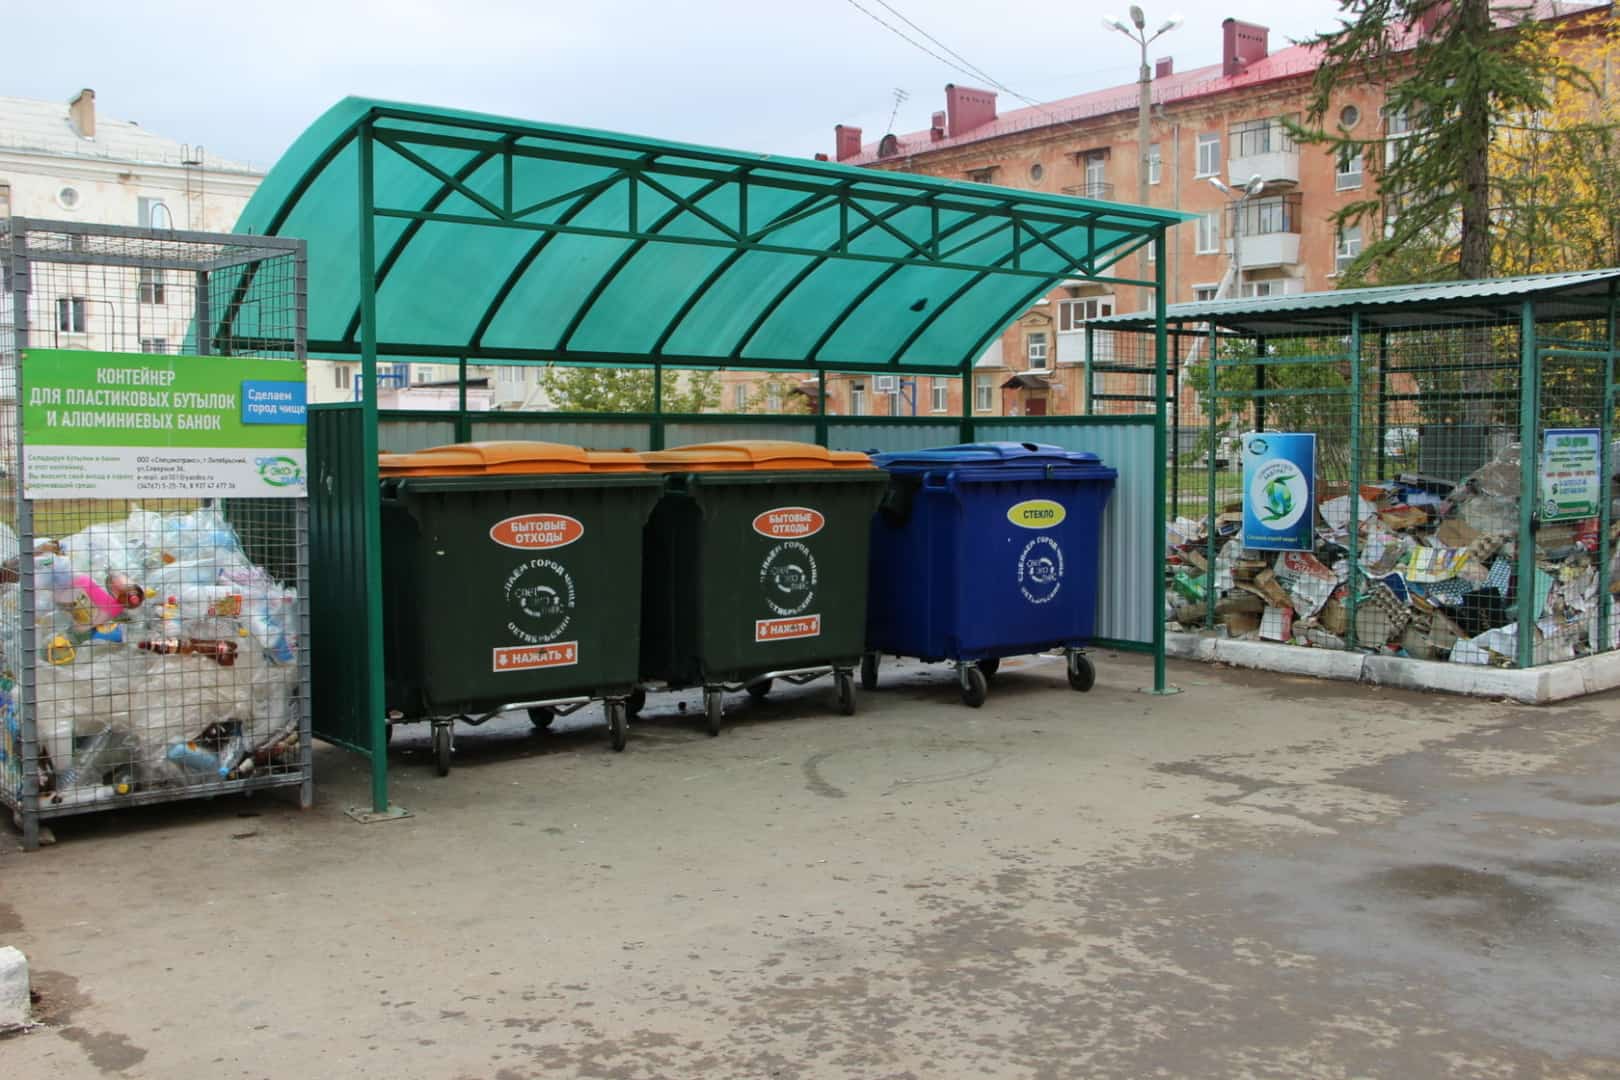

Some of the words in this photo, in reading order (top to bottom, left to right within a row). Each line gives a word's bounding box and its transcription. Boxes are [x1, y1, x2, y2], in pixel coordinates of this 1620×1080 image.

[96, 367, 176, 386] КОНТЕЙНЕР
[30, 387, 61, 406] ДЛЯ
[66, 388, 170, 408] ПЛАСТИКОВЫХ
[173, 392, 236, 409] БУТЫЛОК
[248, 389, 292, 403] Сделаем
[248, 403, 277, 415] город
[279, 404, 305, 416] чище
[47, 411, 57, 427] И
[61, 411, 173, 430] АЛЮМИНИЕВЫХ
[177, 414, 221, 430] БАНОК
[769, 513, 812, 523] БЫТОВЫЕ
[1023, 510, 1054, 519] СТЕКЛО
[511, 520, 567, 532] БЫТОВЫЕ
[772, 524, 809, 534] ОТХОДЫ
[515, 533, 563, 545] ОТХОДЫ
[784, 541, 810, 556] ГОРОД
[530, 559, 565, 576] ГОРОД
[770, 623, 809, 635] НАЖАТЬ
[512, 649, 562, 665] НАЖАТЬ
